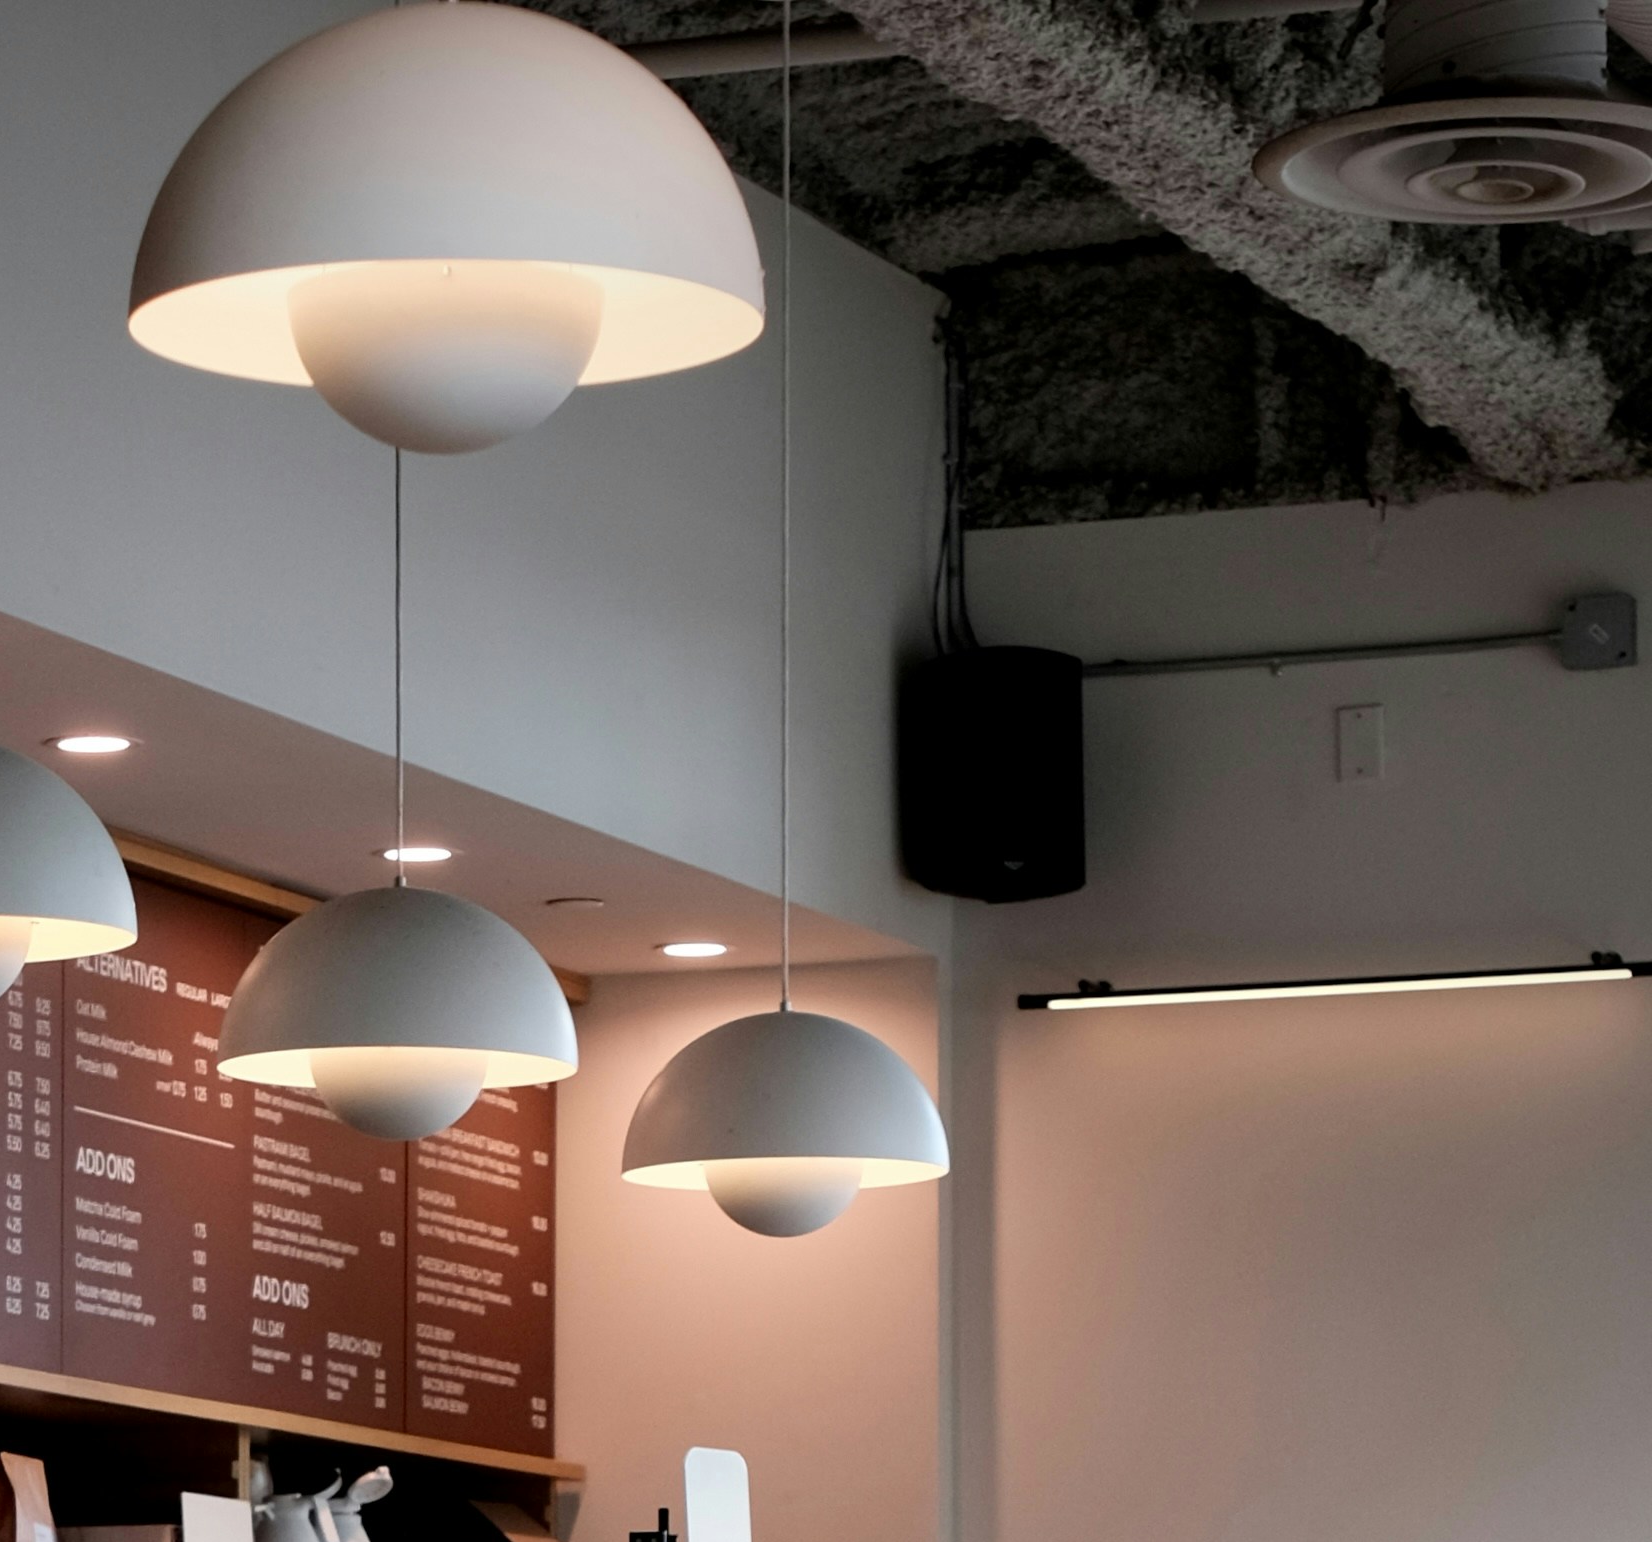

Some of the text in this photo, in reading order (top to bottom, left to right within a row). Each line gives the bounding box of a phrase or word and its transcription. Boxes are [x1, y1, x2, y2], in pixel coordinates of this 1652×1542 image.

[76, 953, 167, 993] ALTERNATIVES
[75, 1146, 135, 1184] ADD ONS
[252, 1274, 309, 1309] ADD ONS
[252, 1317, 285, 1338] ALL DAY
[327, 1332, 382, 1358] BRUNCH ONLY
